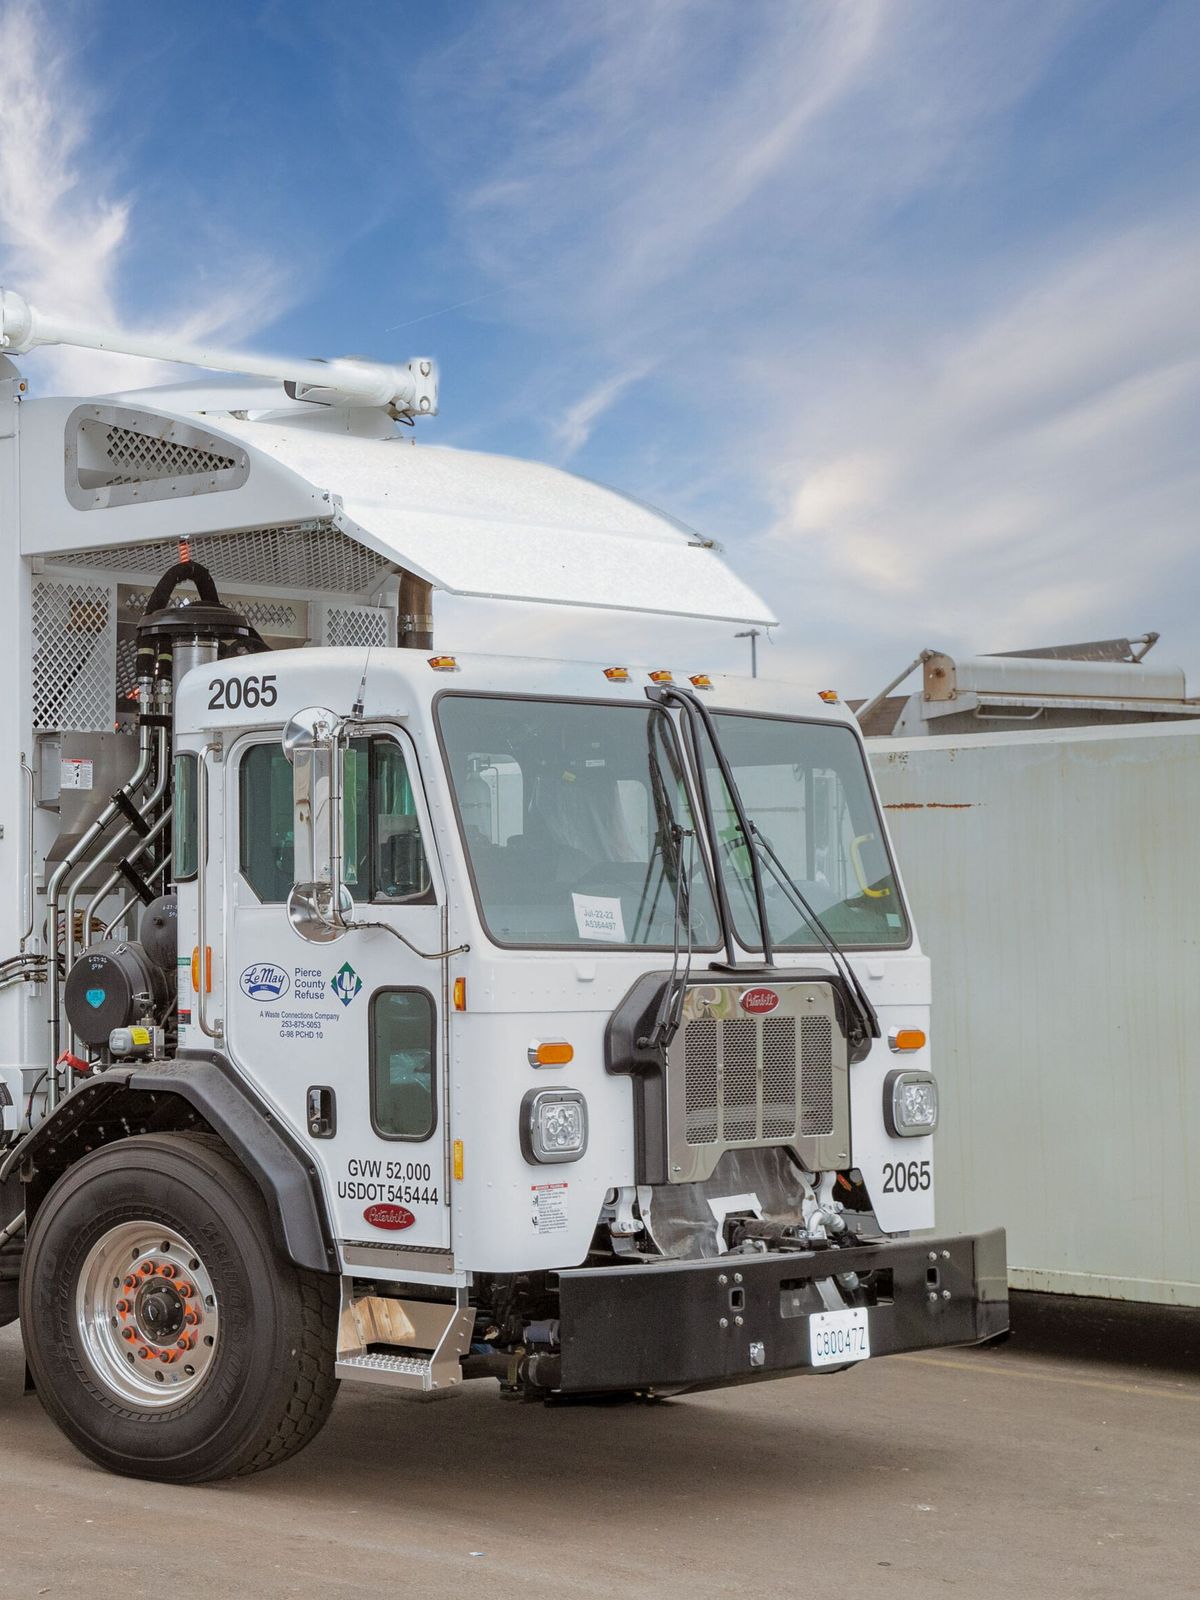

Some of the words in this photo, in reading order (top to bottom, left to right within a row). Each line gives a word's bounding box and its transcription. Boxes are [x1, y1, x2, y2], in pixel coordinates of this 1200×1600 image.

[207, 675, 278, 711] 2065
[244, 967, 285, 988] LeMay
[294, 967, 322, 977] Pierce
[294, 979, 326, 990] County
[294, 990, 325, 999] Refuse
[259, 1010, 264, 1018] A
[265, 1010, 280, 1018] Waste
[281, 1010, 314, 1020] Connections
[314, 1012, 340, 1021] Company
[281, 1020, 321, 1029] 253-875-5053
[316, 1031, 323, 1039] 10
[348, 1159, 382, 1178] GVW
[386, 1162, 431, 1183] 52,000
[882, 1160, 931, 1193] 2065
[369, 1206, 411, 1224] Peterbilt
[816, 1326, 866, 1356] C80047Z
